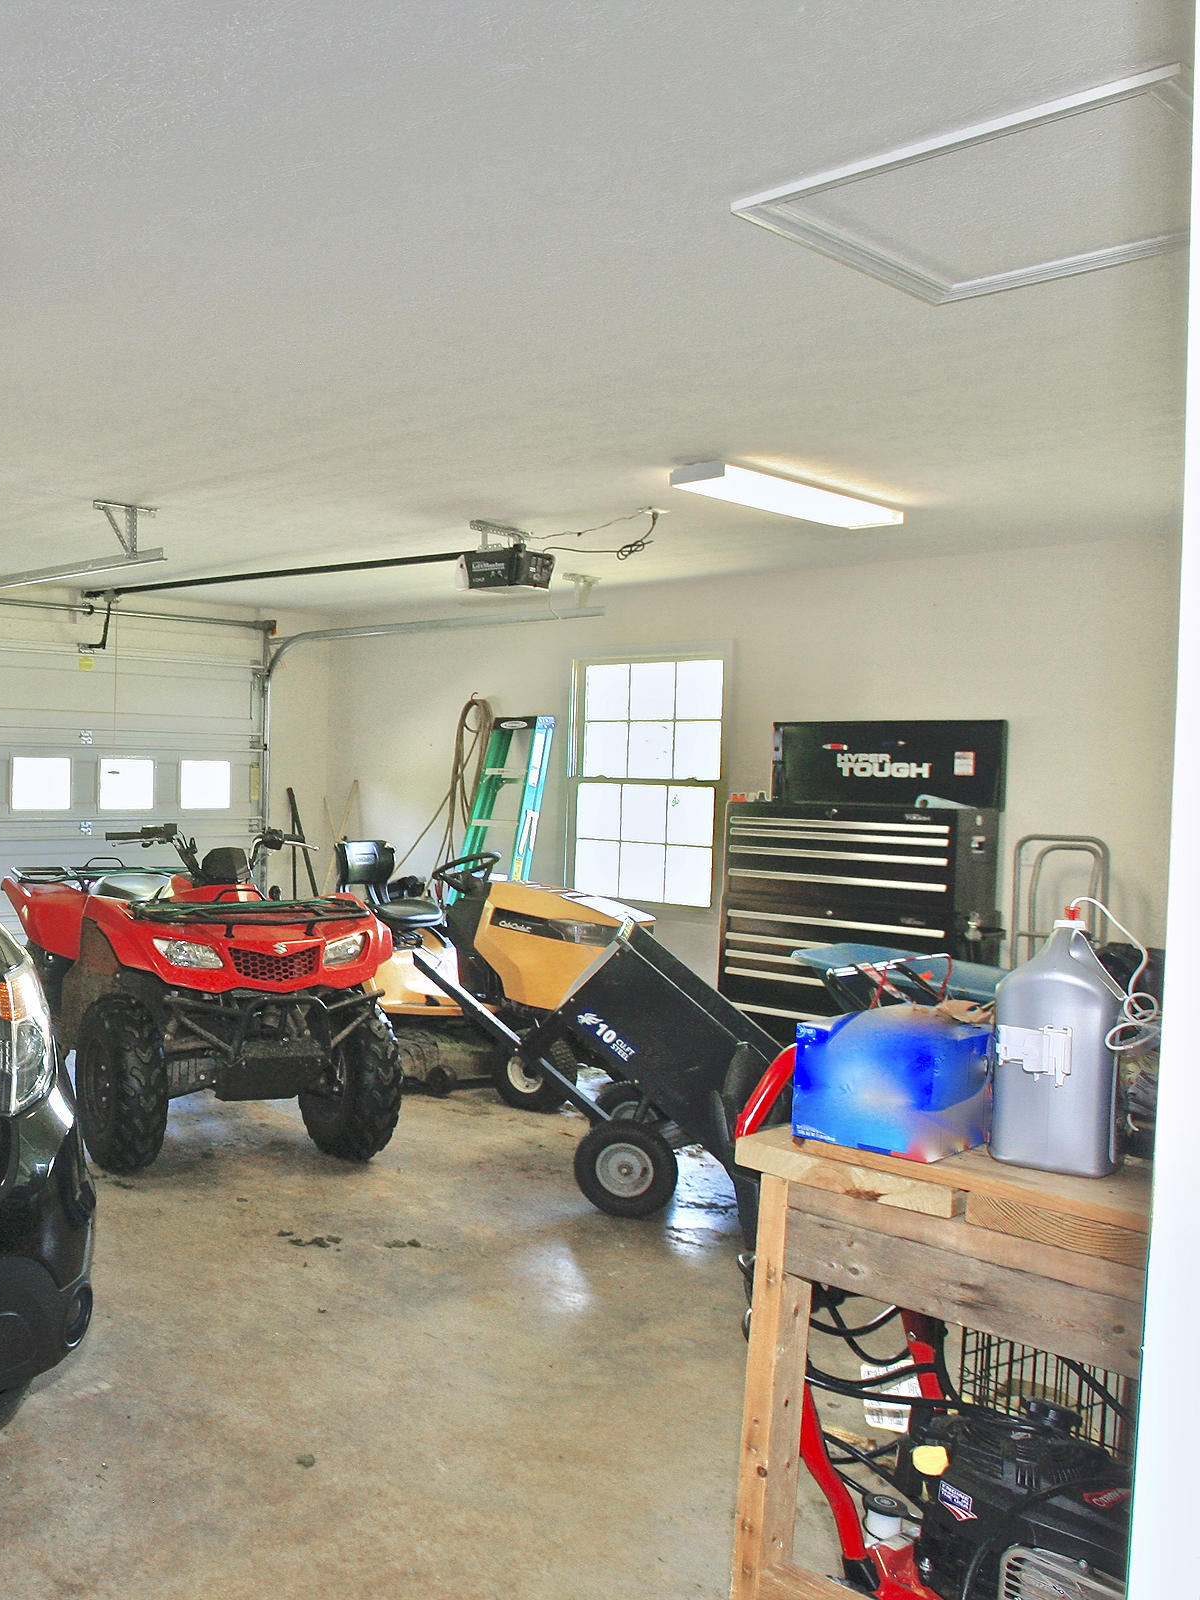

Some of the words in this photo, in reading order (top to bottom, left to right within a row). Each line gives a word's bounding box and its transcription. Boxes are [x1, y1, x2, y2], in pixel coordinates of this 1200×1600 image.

[837, 753, 890, 764] HYPER
[837, 761, 930, 778] TOUGH
[596, 1023, 617, 1043] 10
[610, 1043, 629, 1061] STEEL
